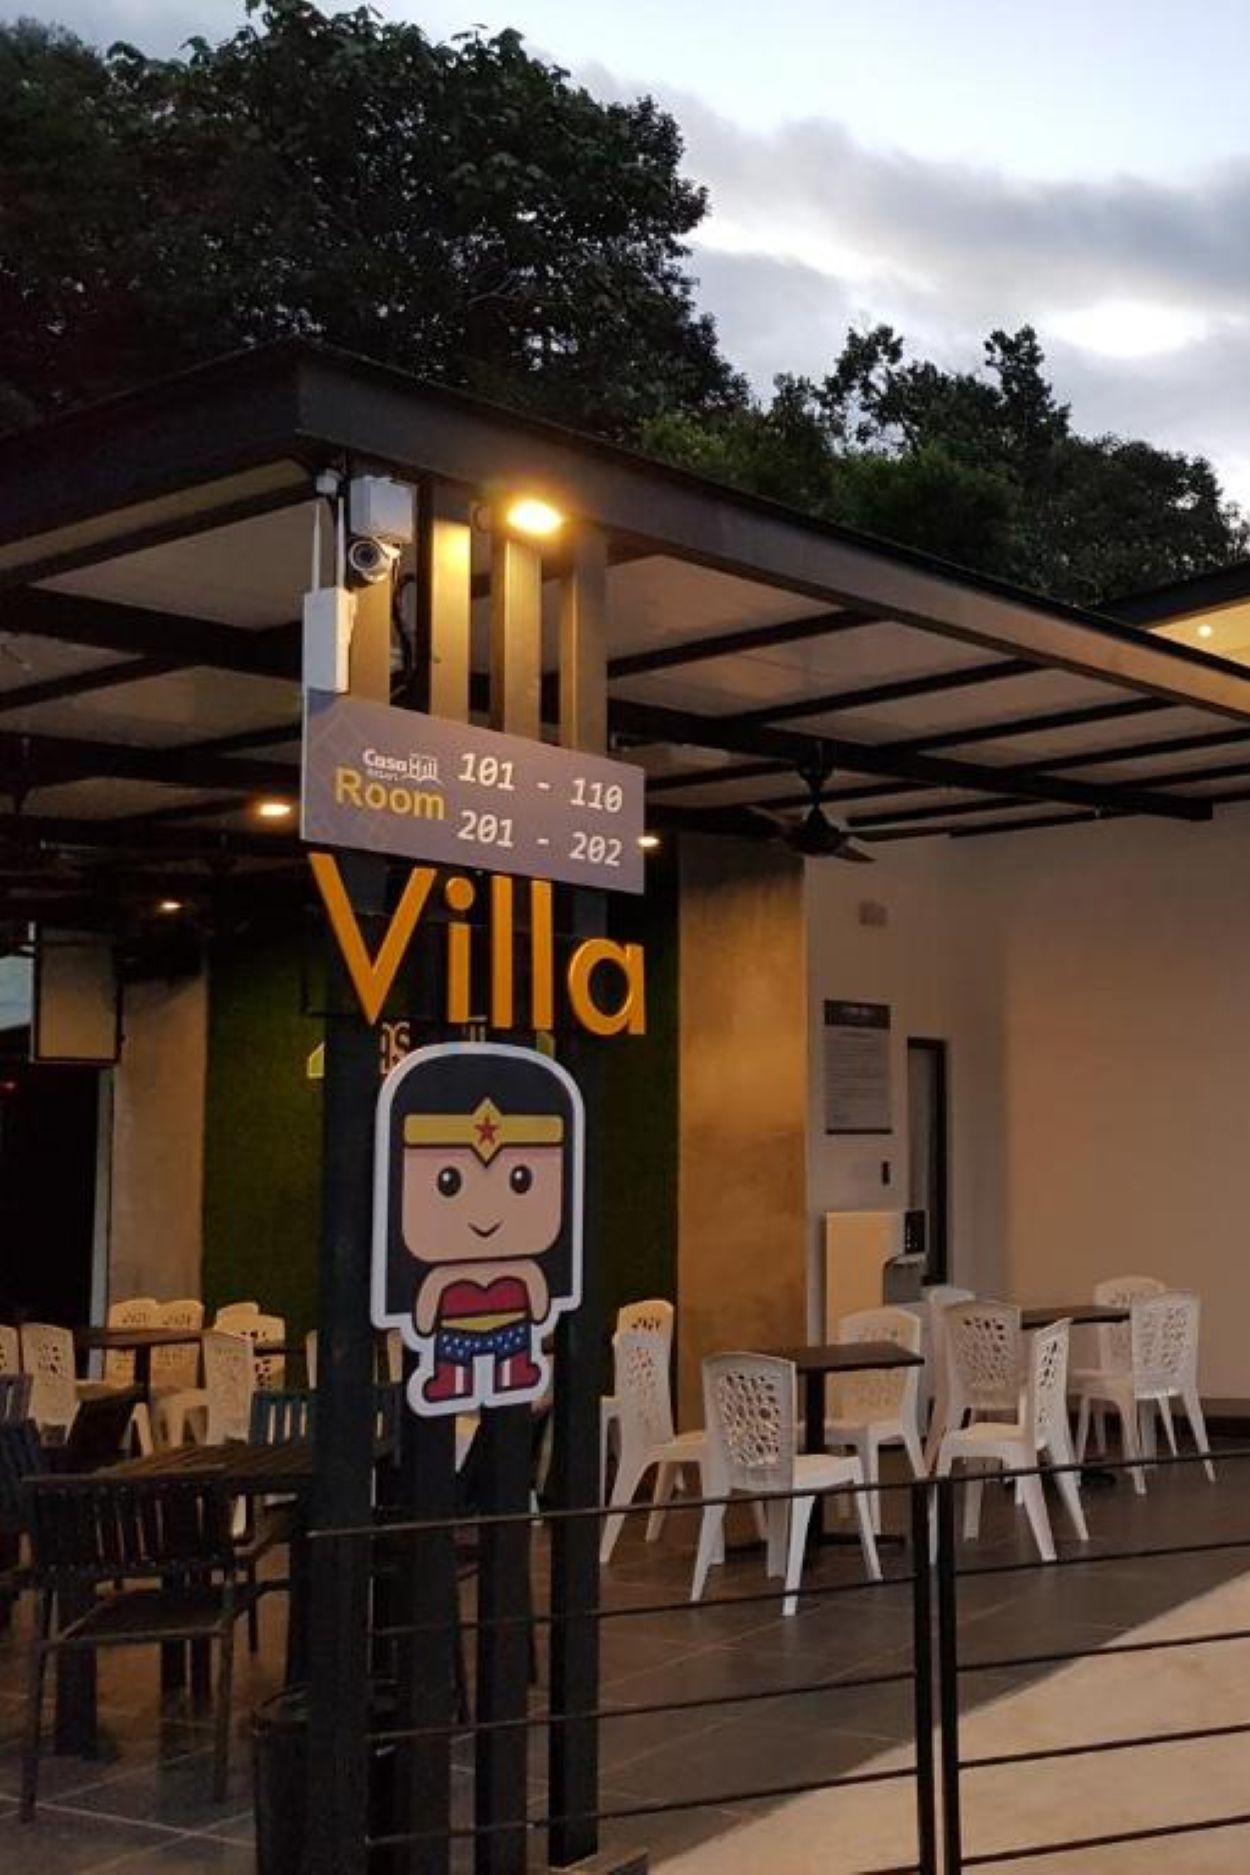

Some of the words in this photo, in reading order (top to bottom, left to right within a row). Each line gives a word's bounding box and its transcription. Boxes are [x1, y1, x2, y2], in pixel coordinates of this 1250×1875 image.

[334, 766, 445, 820] Room
[457, 752, 515, 791] 101
[570, 777, 623, 814] 110
[456, 809, 514, 848] 201
[568, 831, 623, 867] 202
[308, 853, 646, 1036] Villa
